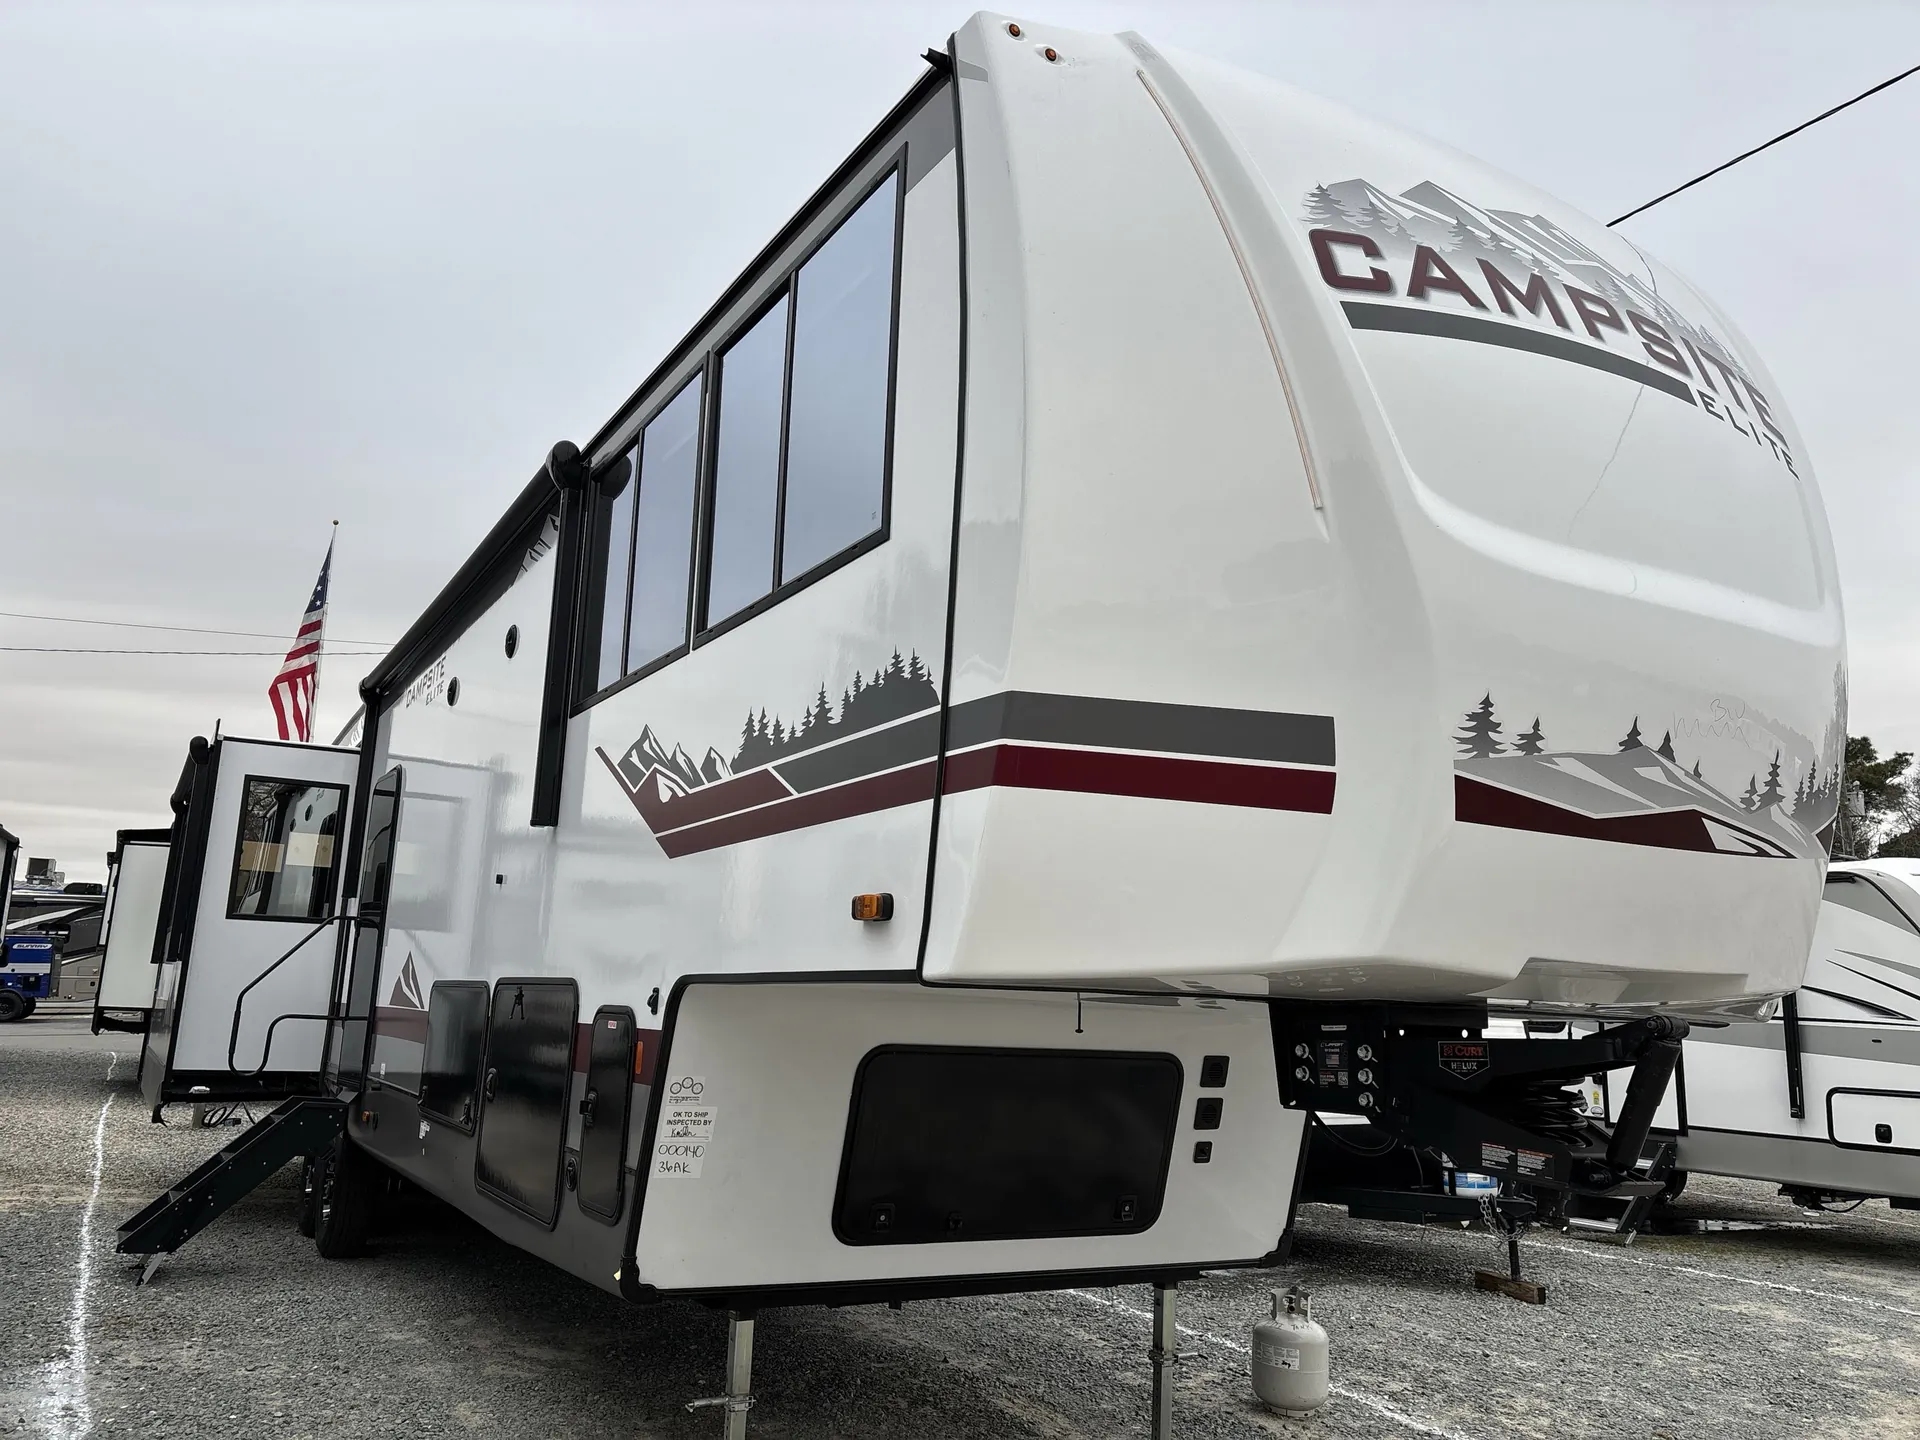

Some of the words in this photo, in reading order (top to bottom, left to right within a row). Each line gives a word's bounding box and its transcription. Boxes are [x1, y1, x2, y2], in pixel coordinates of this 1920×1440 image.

[1308, 228, 1791, 449] CAMPSITE
[1696, 388, 1800, 481] ELITE
[405, 655, 447, 708] CAMPSITE
[425, 680, 445, 706] ELITE
[658, 1144, 705, 1158] 000140
